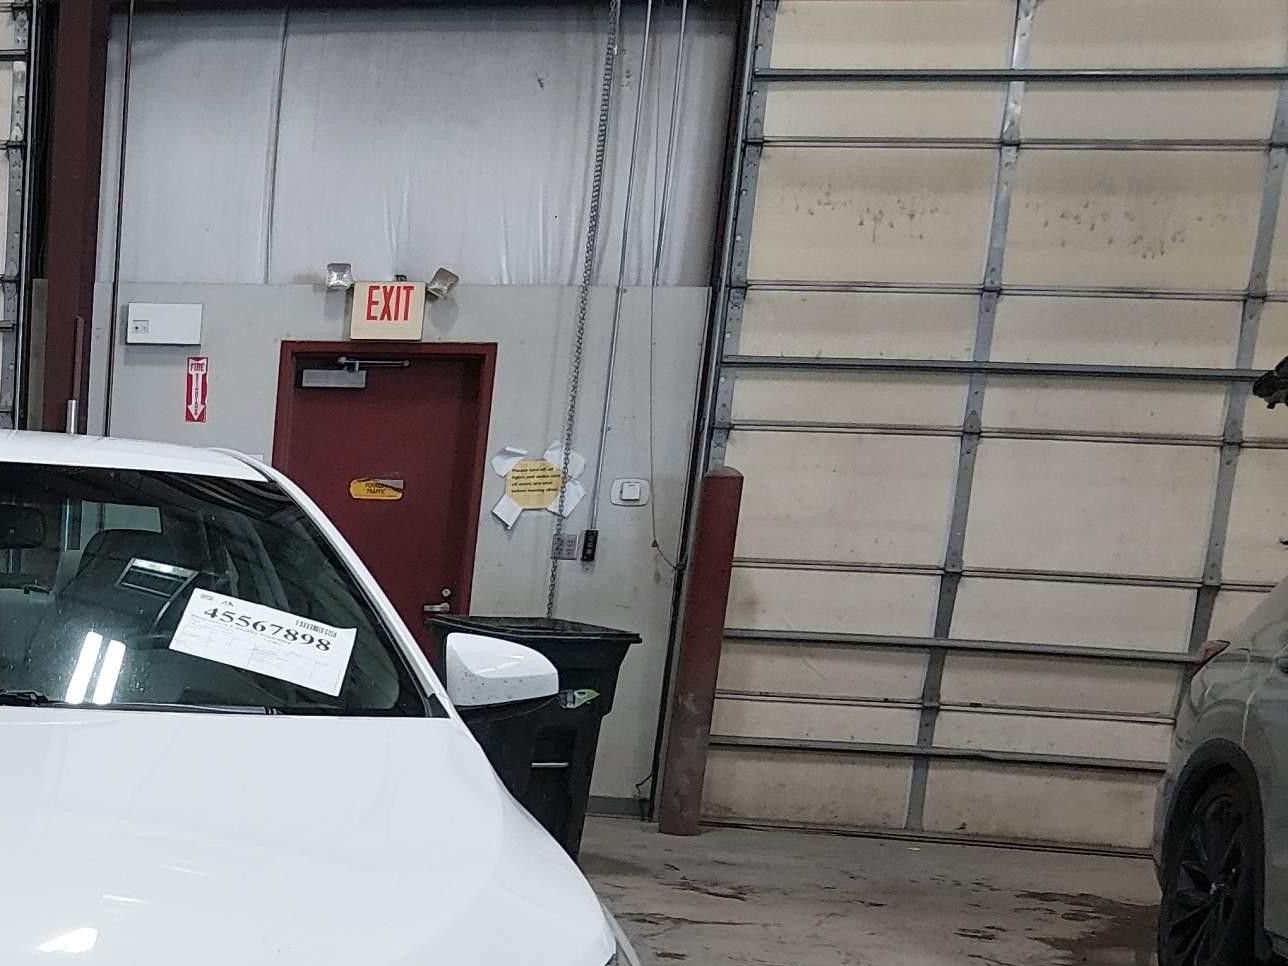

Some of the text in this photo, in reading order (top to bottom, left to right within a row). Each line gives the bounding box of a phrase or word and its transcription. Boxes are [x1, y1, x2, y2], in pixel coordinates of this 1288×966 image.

[366, 286, 414, 321] EXIT
[190, 363, 205, 372] FIRE
[203, 607, 331, 652] 45567898
